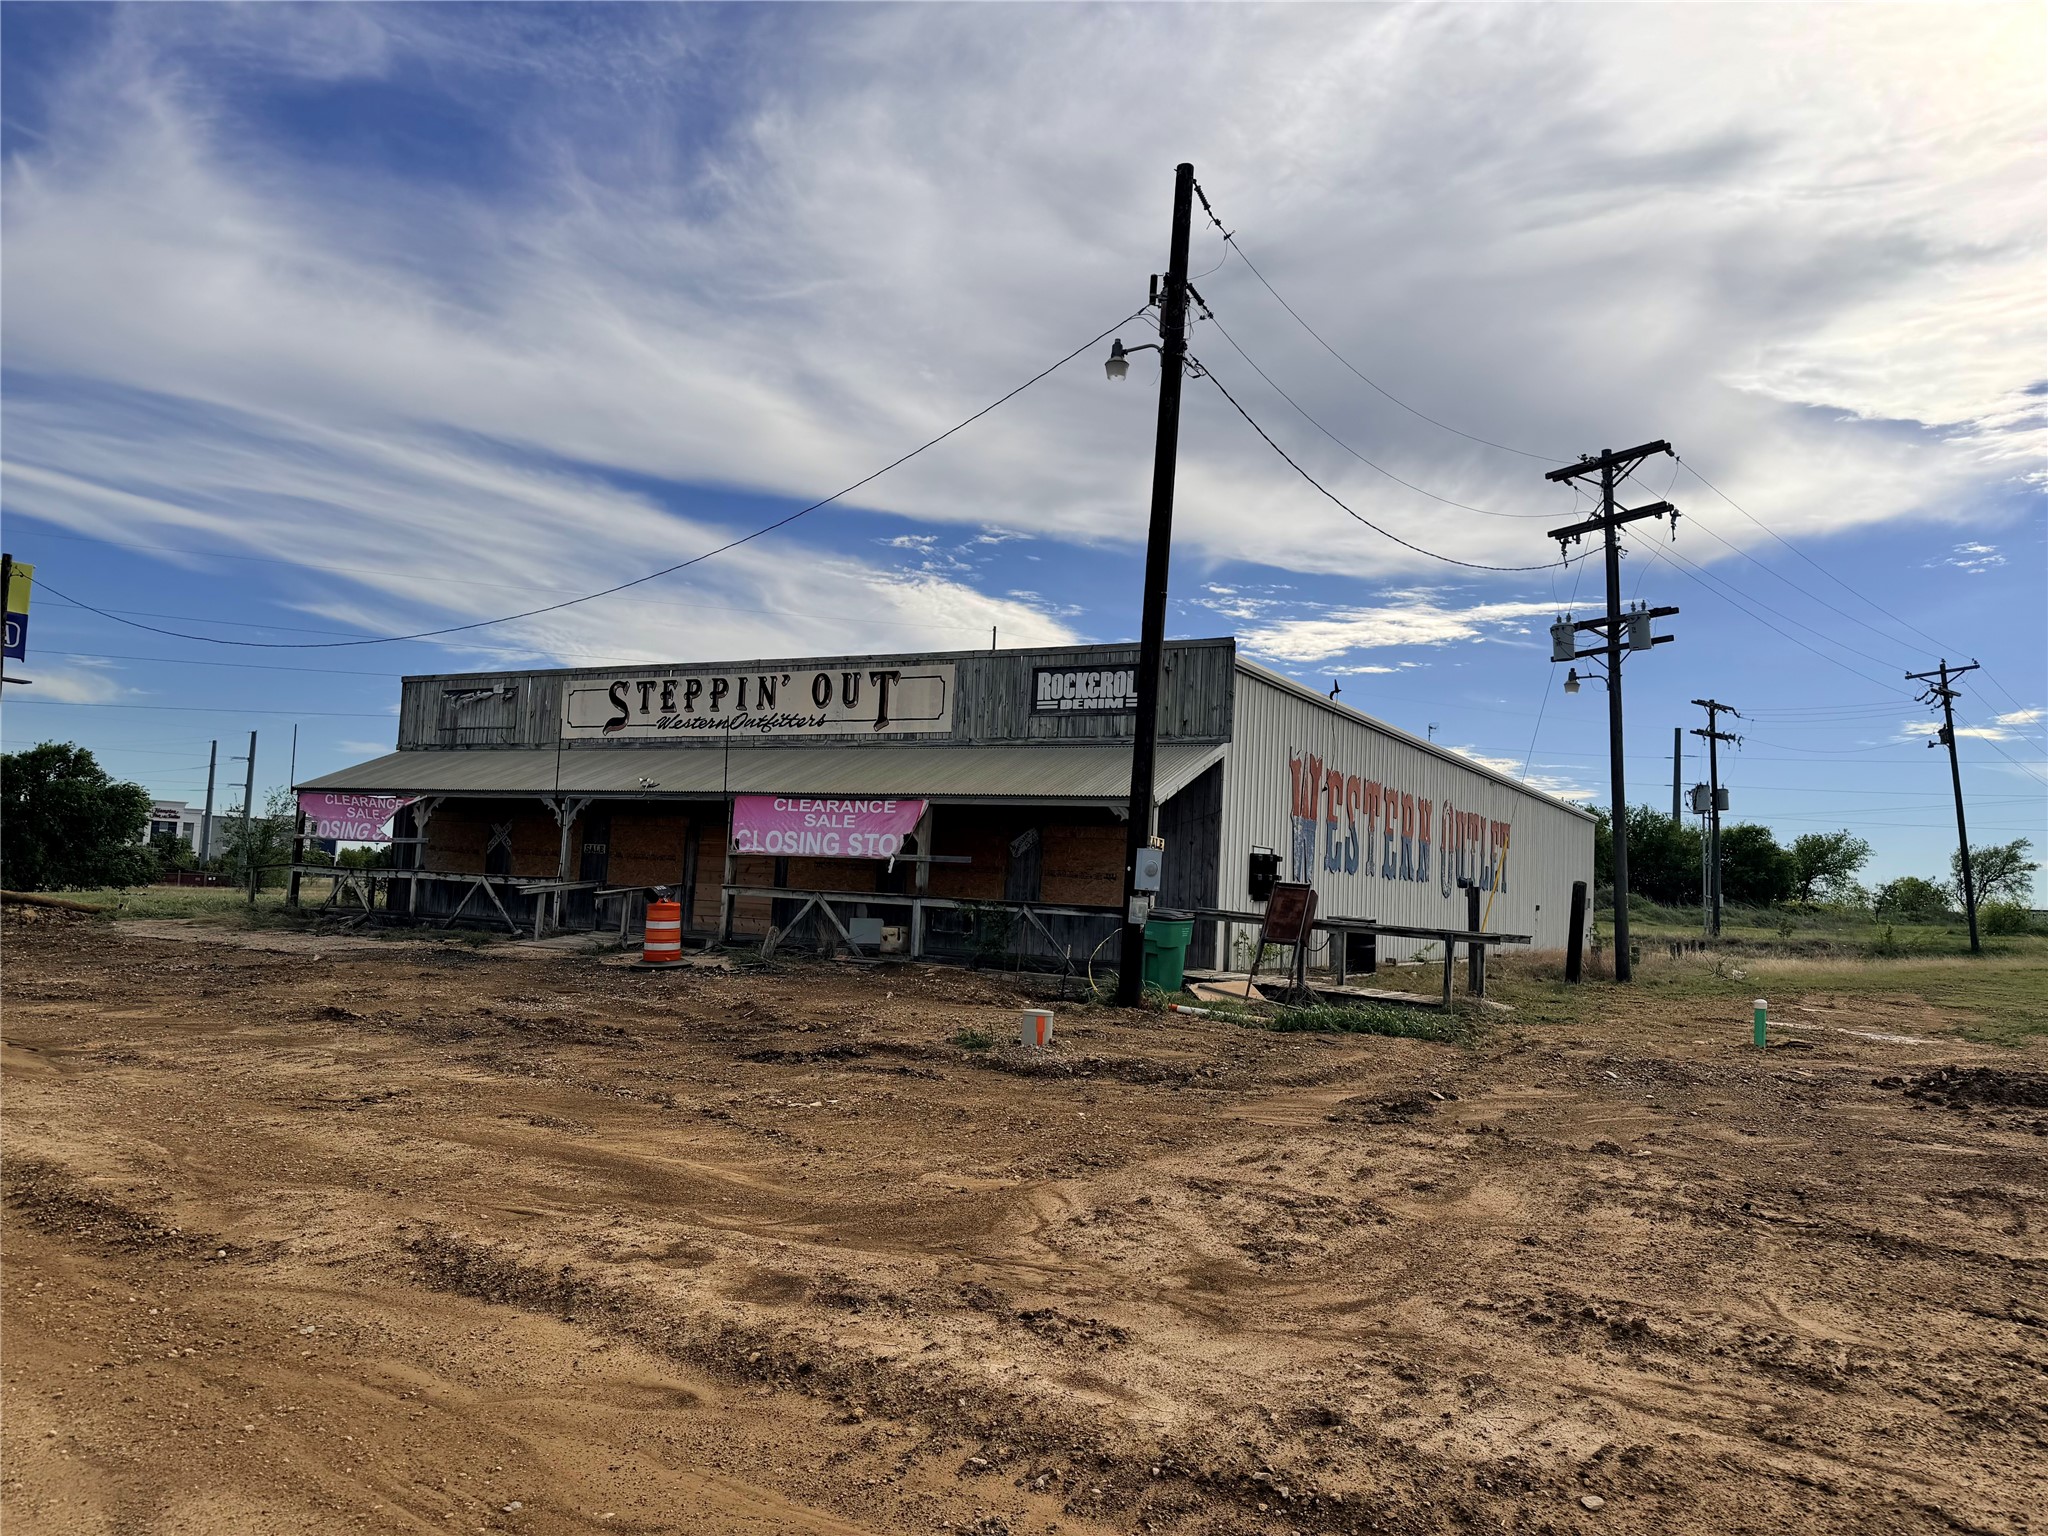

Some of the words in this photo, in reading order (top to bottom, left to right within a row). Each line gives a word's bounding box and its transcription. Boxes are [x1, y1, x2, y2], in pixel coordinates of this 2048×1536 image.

[603, 674, 791, 736] STEPPIN'
[811, 670, 901, 732] OUT
[1060, 698, 1124, 710] DENIM
[325, 794, 404, 809] CLEARANCE
[773, 798, 897, 814] CLEARANCE
[346, 807, 380, 820] SALE
[803, 813, 856, 828] SALE
[318, 820, 371, 840] OSING
[1289, 746, 1433, 883] WESTERN
[1440, 800, 1511, 899] OUTLET
[736, 829, 840, 855] CLOSING
[847, 833, 904, 857] STO
[1150, 837, 1163, 850] ALE
